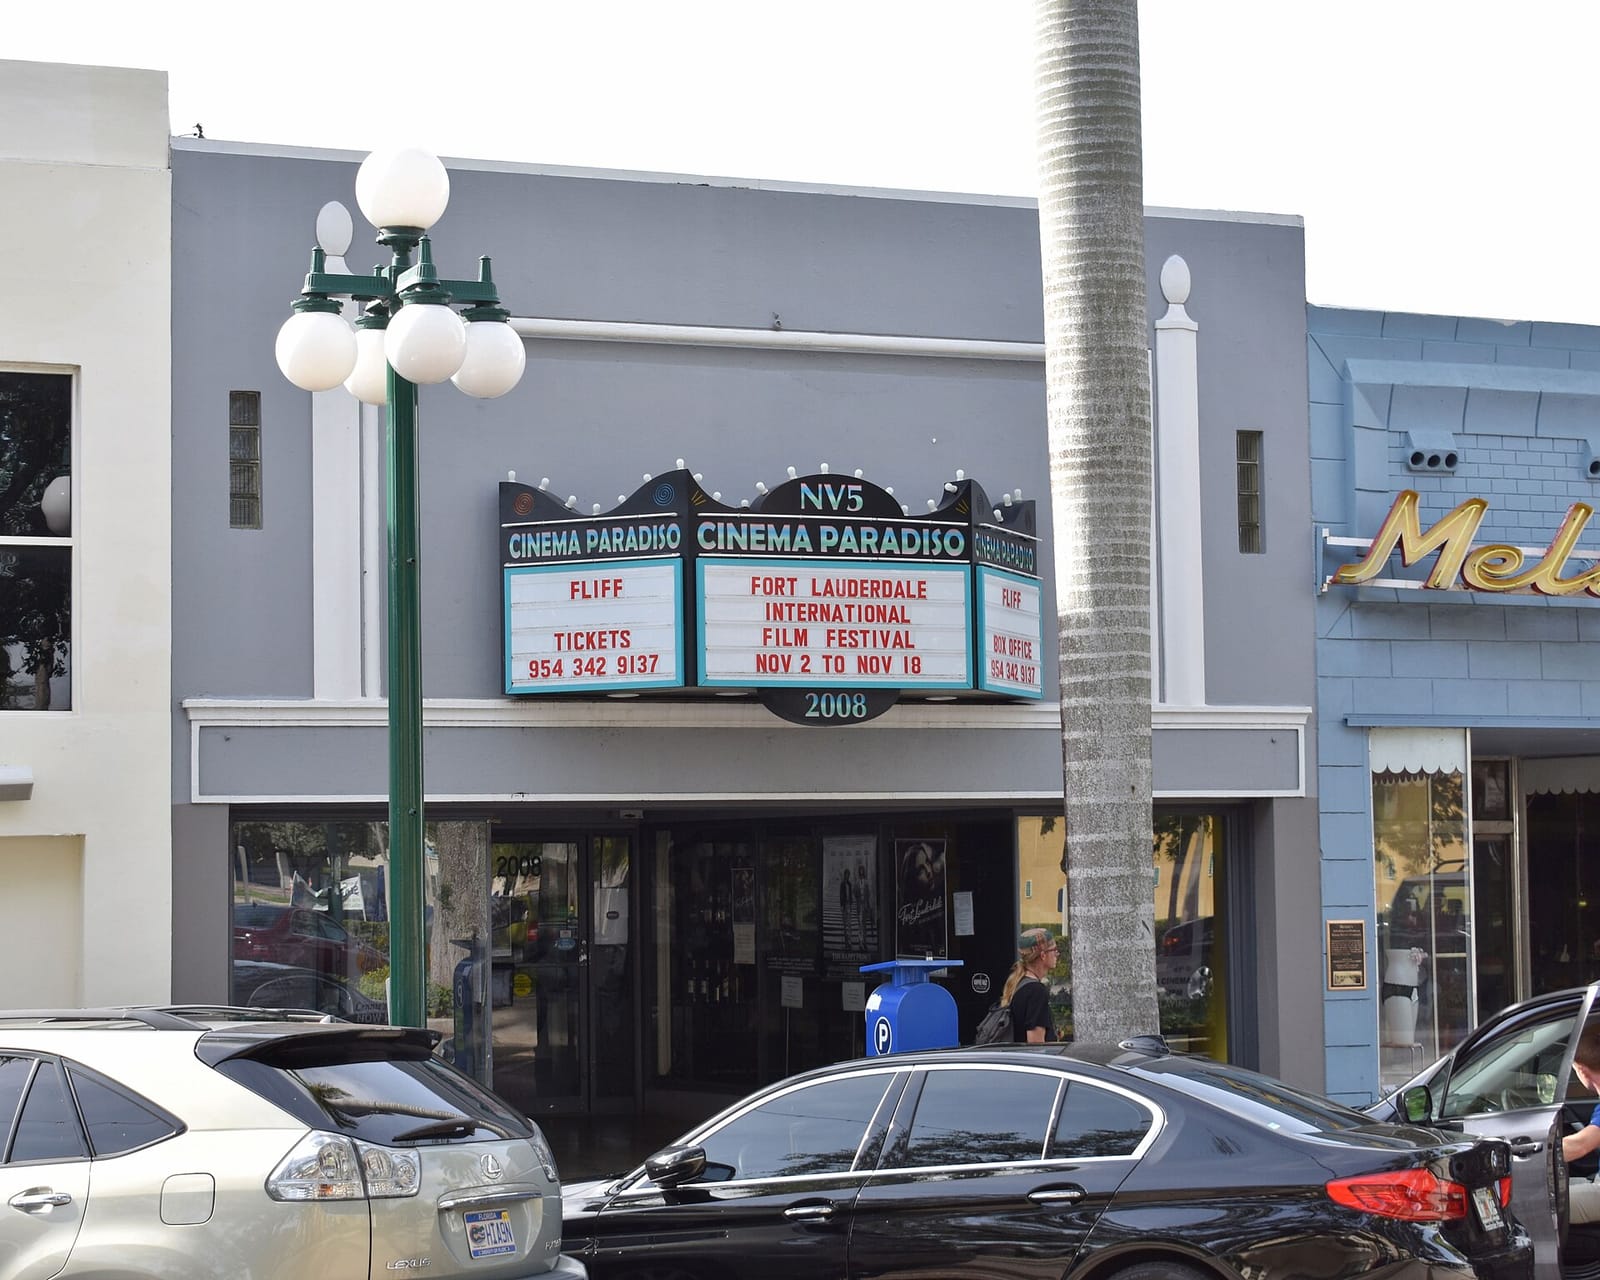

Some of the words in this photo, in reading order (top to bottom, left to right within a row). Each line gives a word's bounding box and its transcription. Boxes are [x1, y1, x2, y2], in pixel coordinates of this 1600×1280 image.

[800, 482, 865, 512] NV5
[508, 530, 581, 559] CINEMA
[586, 523, 681, 553] PARADISO
[697, 521, 814, 553] CINEMA
[820, 525, 966, 557] PARADISO
[1329, 489, 1600, 599] Mel
[974, 532, 1001, 562] CINEMA
[1001, 540, 1034, 571] PARADISO
[570, 579, 623, 599] FLIFF
[751, 576, 798, 596] FORT
[811, 578, 927, 599] LAUDERDALE
[1002, 588, 1022, 609] FLIFF
[765, 602, 911, 624] INTERNATIONAL
[554, 630, 631, 651] TICKETS
[762, 628, 808, 647] FILM
[826, 629, 915, 649] FESTIVAL
[993, 635, 1006, 655] BOX
[1009, 637, 1032, 660] OFFICE
[529, 659, 563, 678] 954
[573, 657, 607, 676] 342
[617, 654, 659, 674] 9137
[756, 653, 792, 673] NOV
[800, 654, 811, 673] 2
[822, 655, 845, 673] TO
[857, 655, 892, 674] NOV
[904, 656, 921, 674] 18
[991, 659, 1004, 678] 954
[1006, 661, 1018, 681] 342
[1020, 664, 1035, 684] 9137
[805, 692, 867, 718] 2008
[496, 855, 542, 876] 2008
[879, 1023, 889, 1051] P
[386, 1258, 432, 1270] LEXUS
